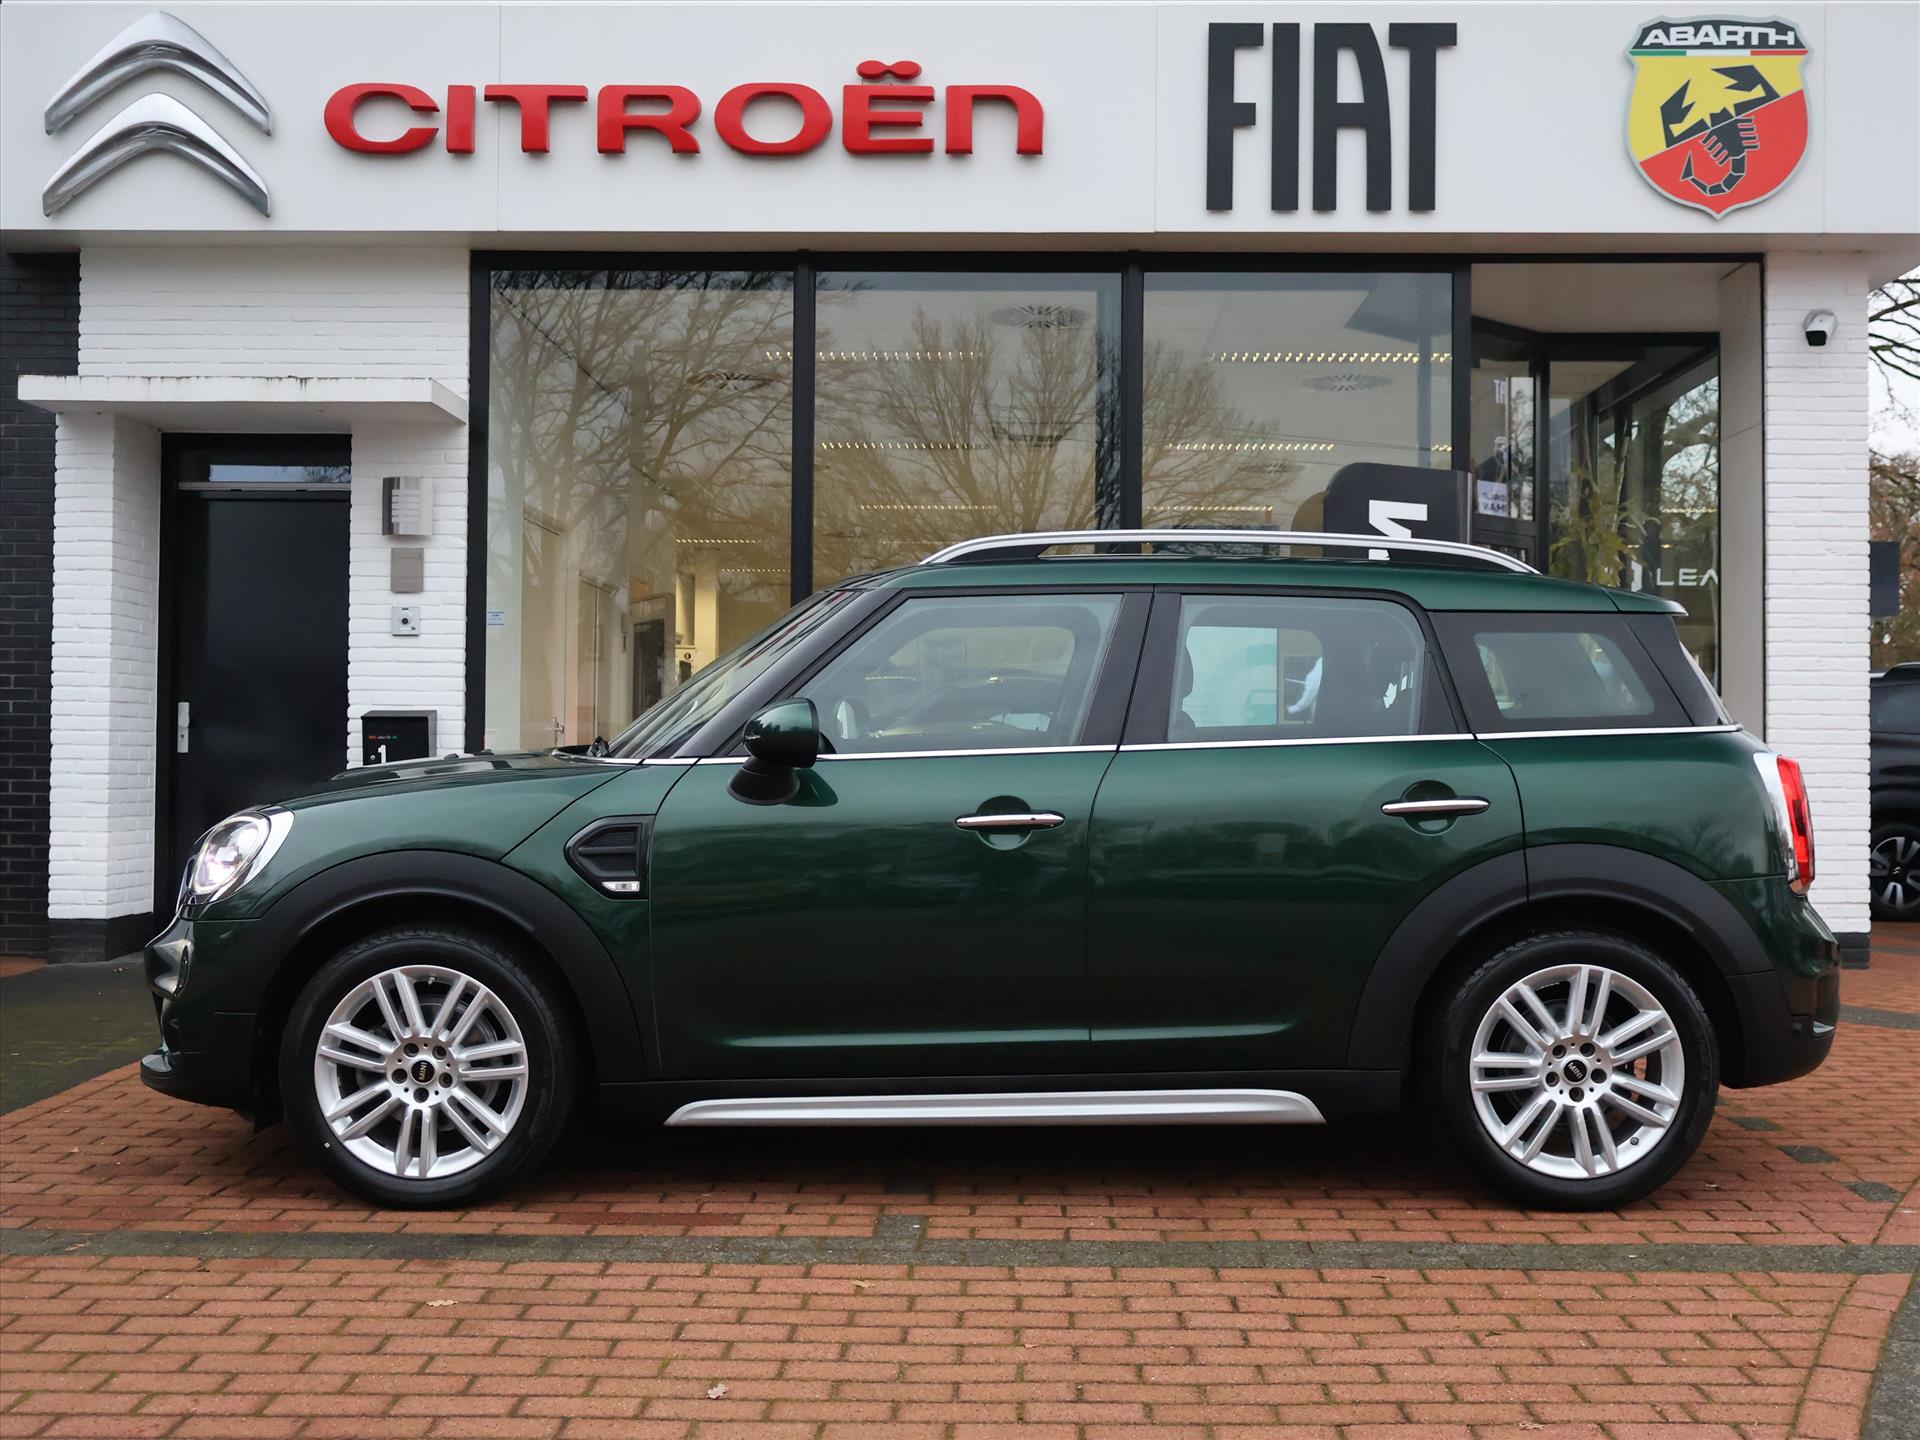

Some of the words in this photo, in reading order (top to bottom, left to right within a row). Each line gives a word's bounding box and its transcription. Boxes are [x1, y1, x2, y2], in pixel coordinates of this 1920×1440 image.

[1641, 25, 1795, 46] ABARTH
[1206, 22, 1458, 211] FIAT
[419, 1062, 428, 1081] MINI
[1567, 1062, 1584, 1079] MINI
